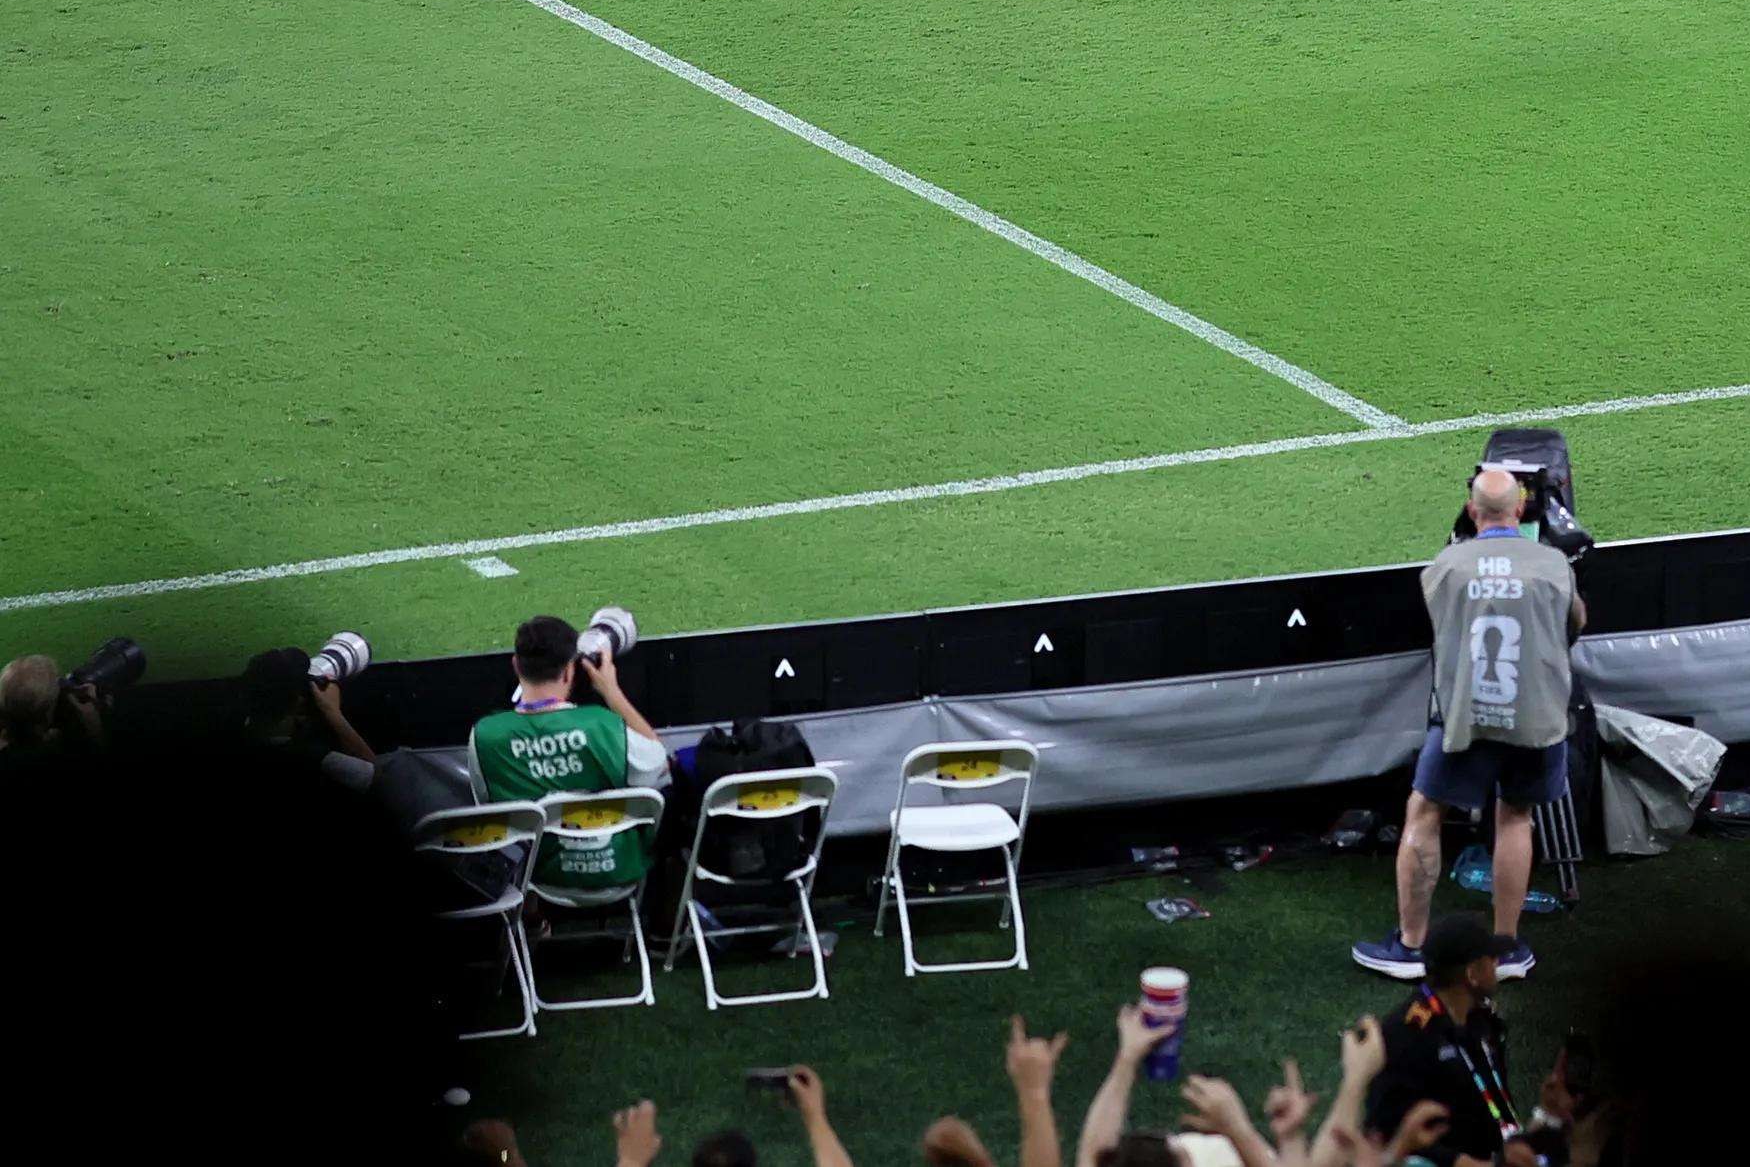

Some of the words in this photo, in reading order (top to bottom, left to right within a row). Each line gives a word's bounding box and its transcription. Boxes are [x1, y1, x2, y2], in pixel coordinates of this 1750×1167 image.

[1477, 556, 1512, 576] HB
[1468, 578, 1523, 600] 0523
[511, 730, 587, 758] PHOTO
[528, 754, 583, 778] 0636
